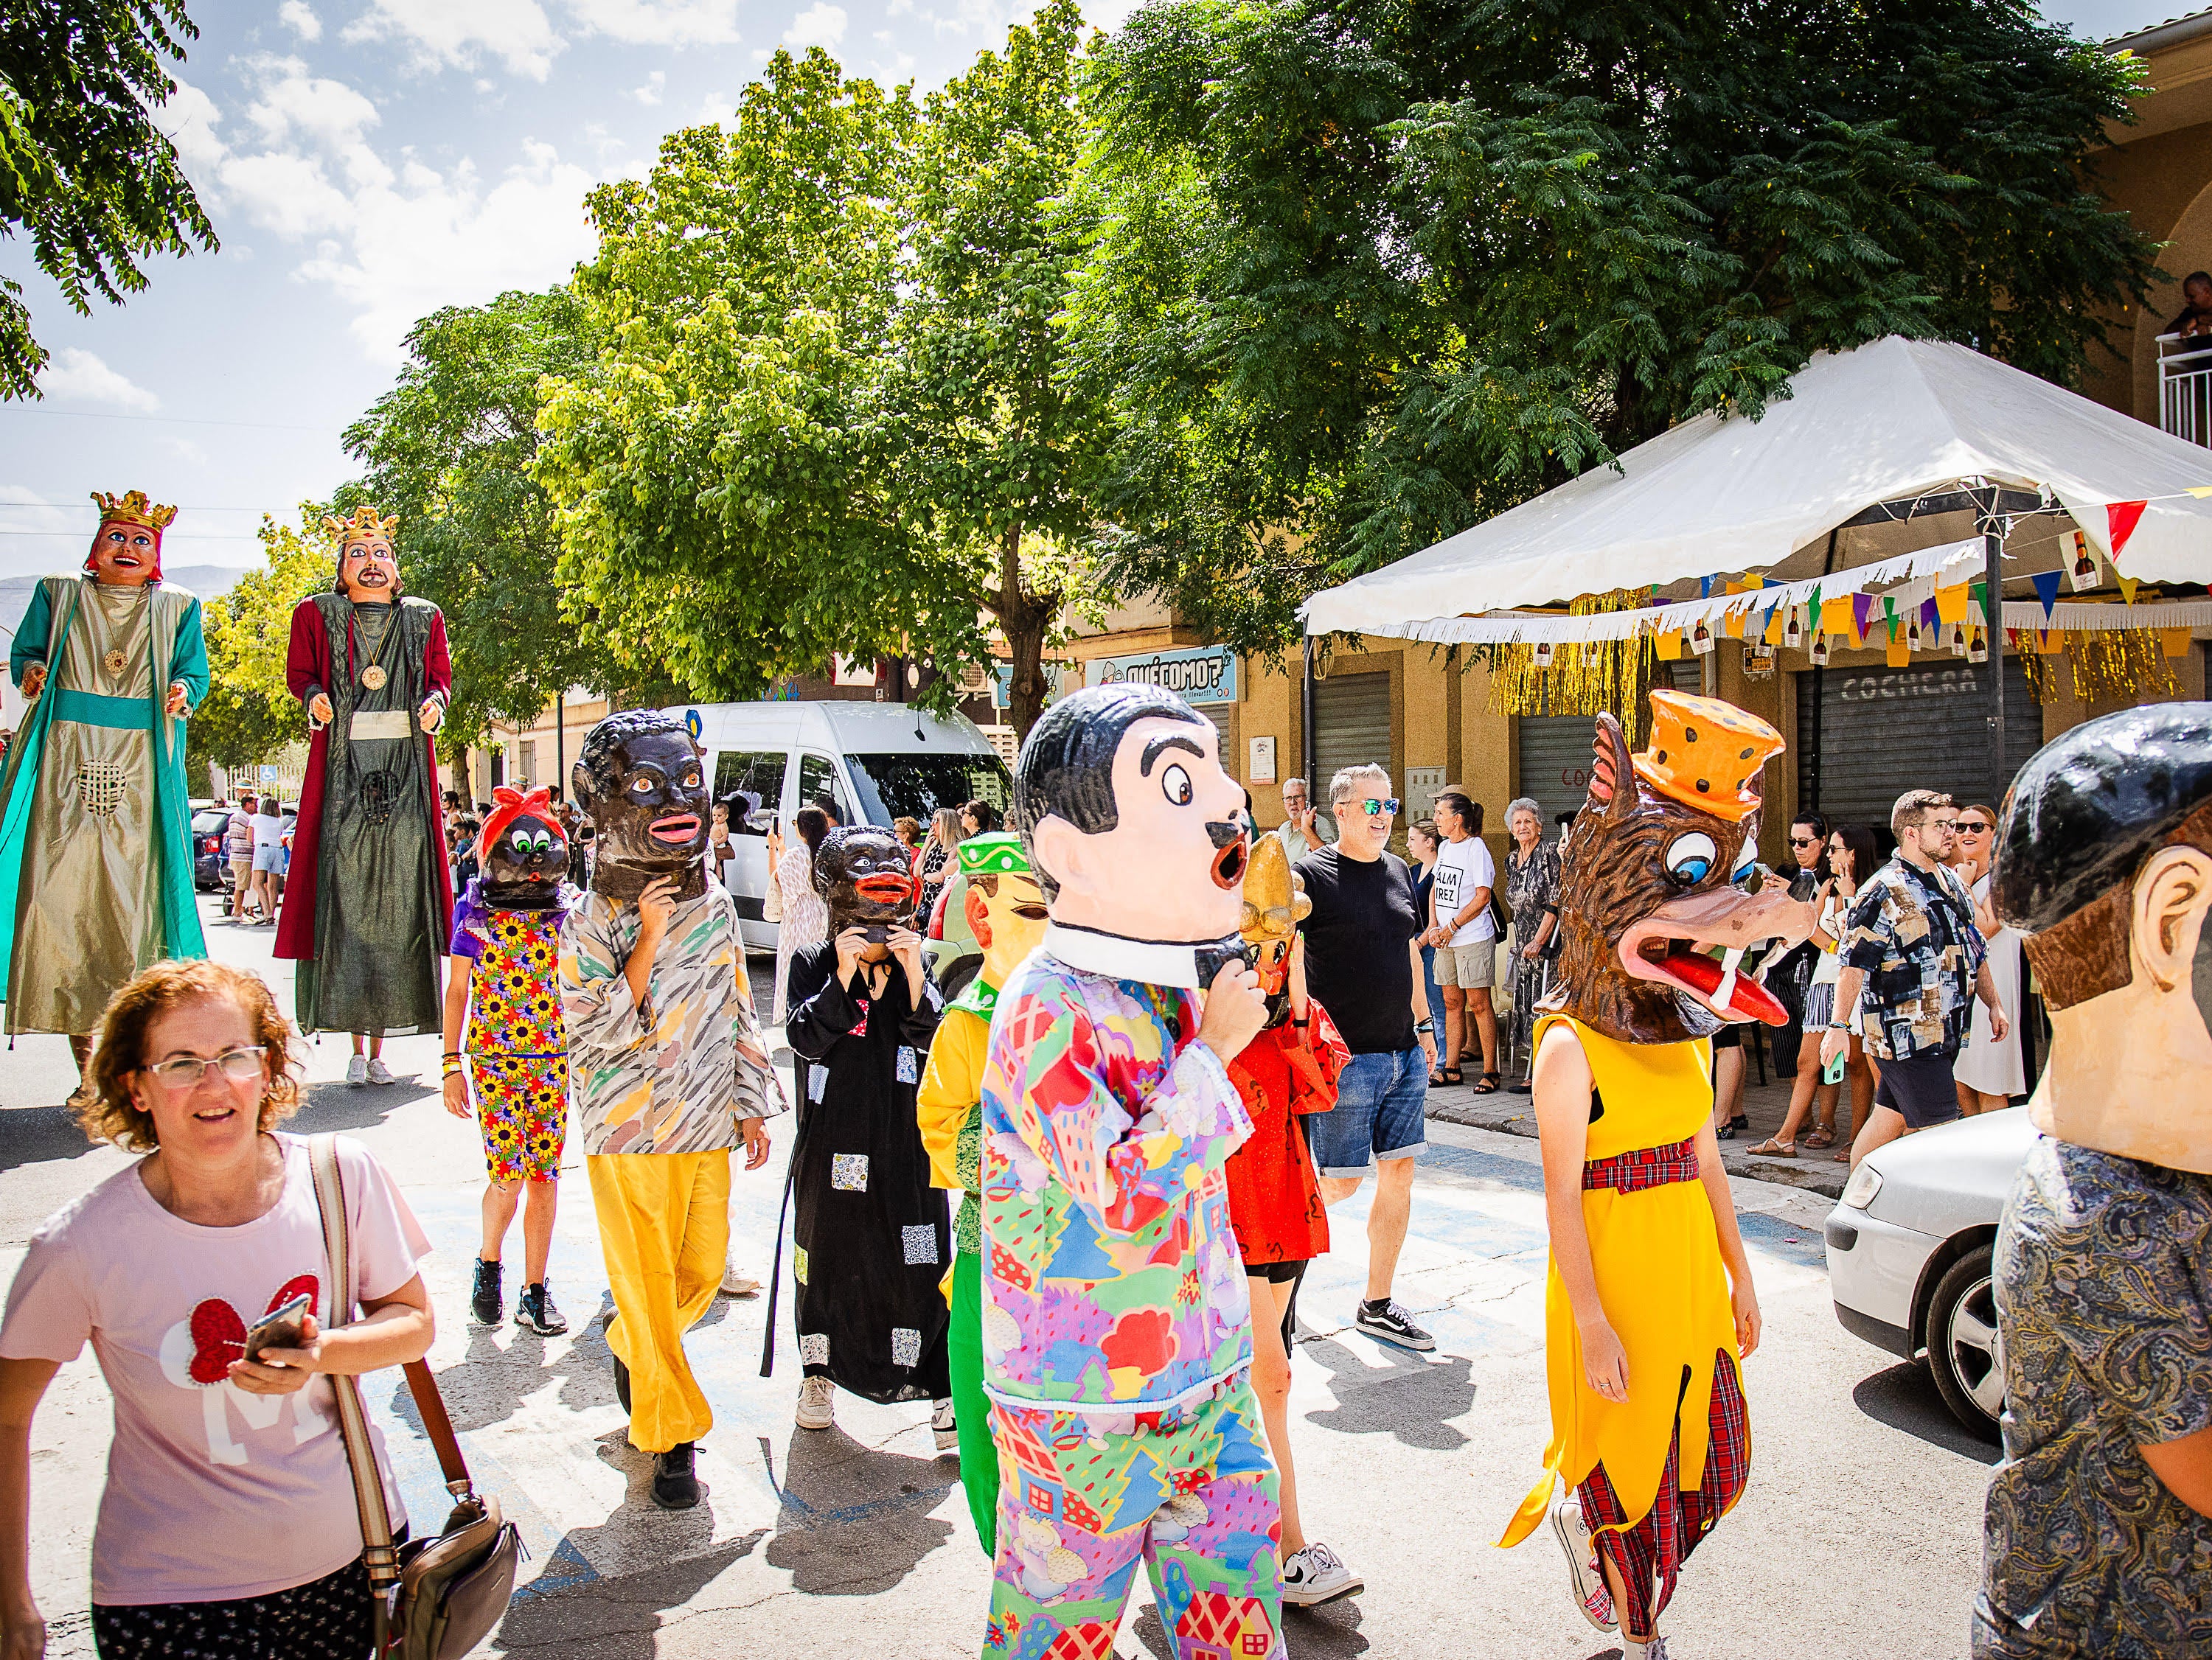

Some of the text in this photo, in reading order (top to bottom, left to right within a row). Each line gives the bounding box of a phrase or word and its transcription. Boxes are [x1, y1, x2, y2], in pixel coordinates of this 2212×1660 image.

[1841, 669, 1977, 700] COCHERA
[1436, 871, 1457, 886] ALM
[1436, 887, 1455, 902] IREZ
